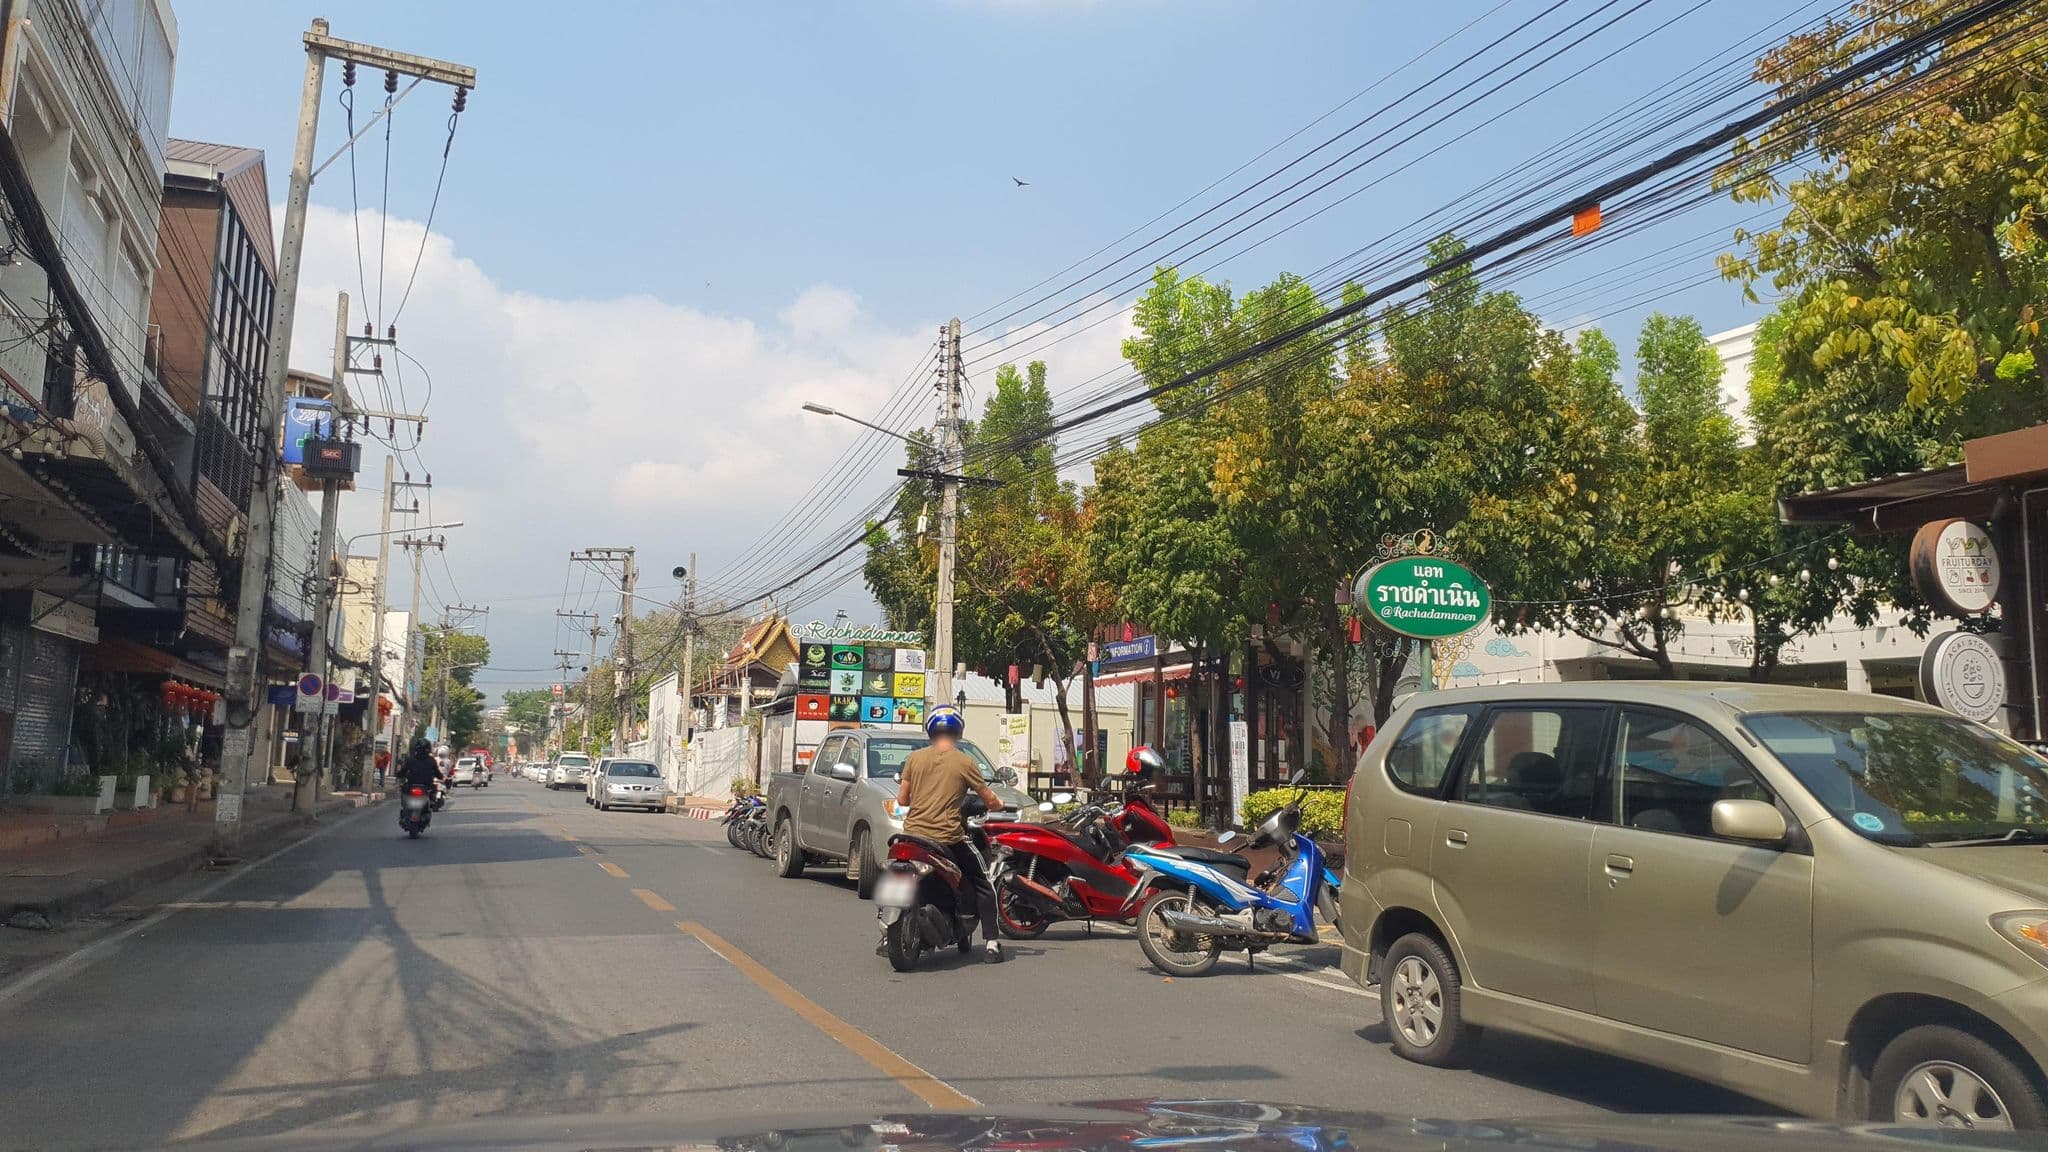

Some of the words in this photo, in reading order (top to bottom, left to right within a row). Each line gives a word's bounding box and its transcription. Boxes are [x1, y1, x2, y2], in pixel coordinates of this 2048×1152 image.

[1942, 558, 1992, 568] FRUITURDAY
[1413, 565, 1443, 579] แอท
[1376, 580, 1480, 608] ราชดำเนิน
[1381, 605, 1477, 621] @Rachadamnoen
[1110, 642, 1143, 657] NFORMATION
[1968, 639, 1994, 658] STORY
